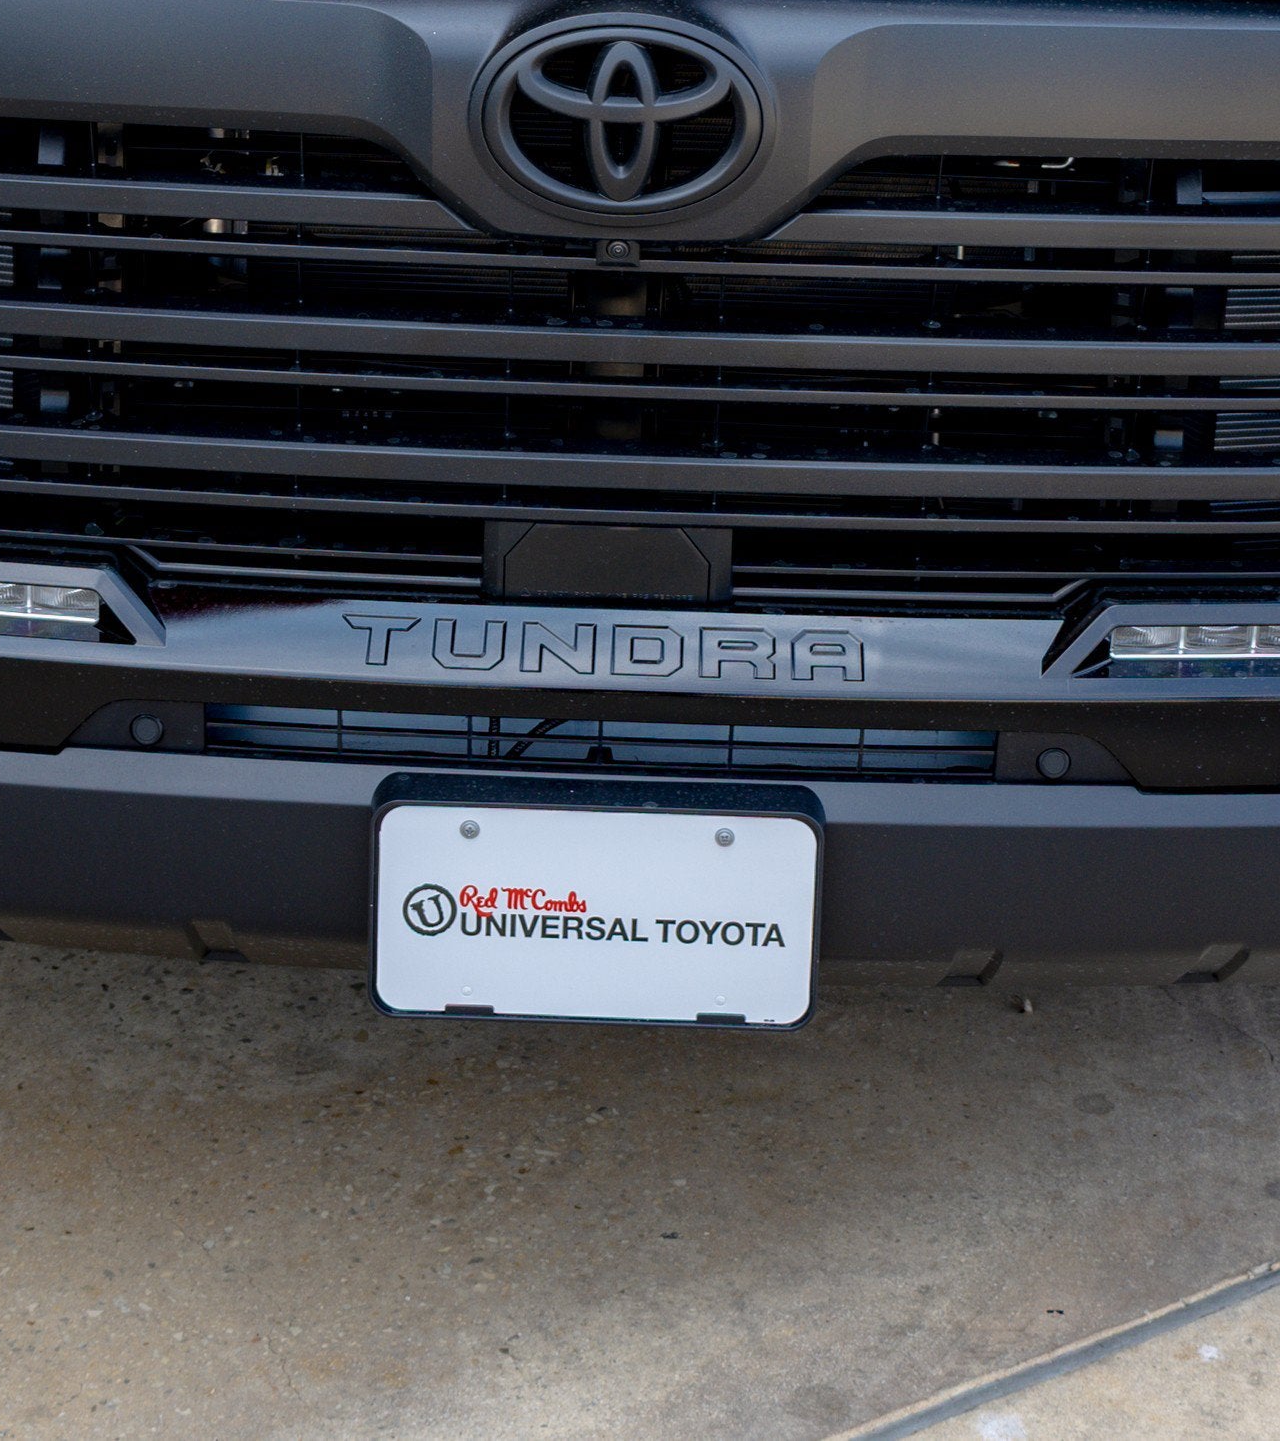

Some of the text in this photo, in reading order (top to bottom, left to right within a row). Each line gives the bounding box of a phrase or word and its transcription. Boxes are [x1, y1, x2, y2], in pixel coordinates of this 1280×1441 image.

[341, 612, 865, 682] TUNDRA
[459, 884, 587, 917] Red McCombs
[460, 912, 786, 947] UNIVERSAL TOYOTA
